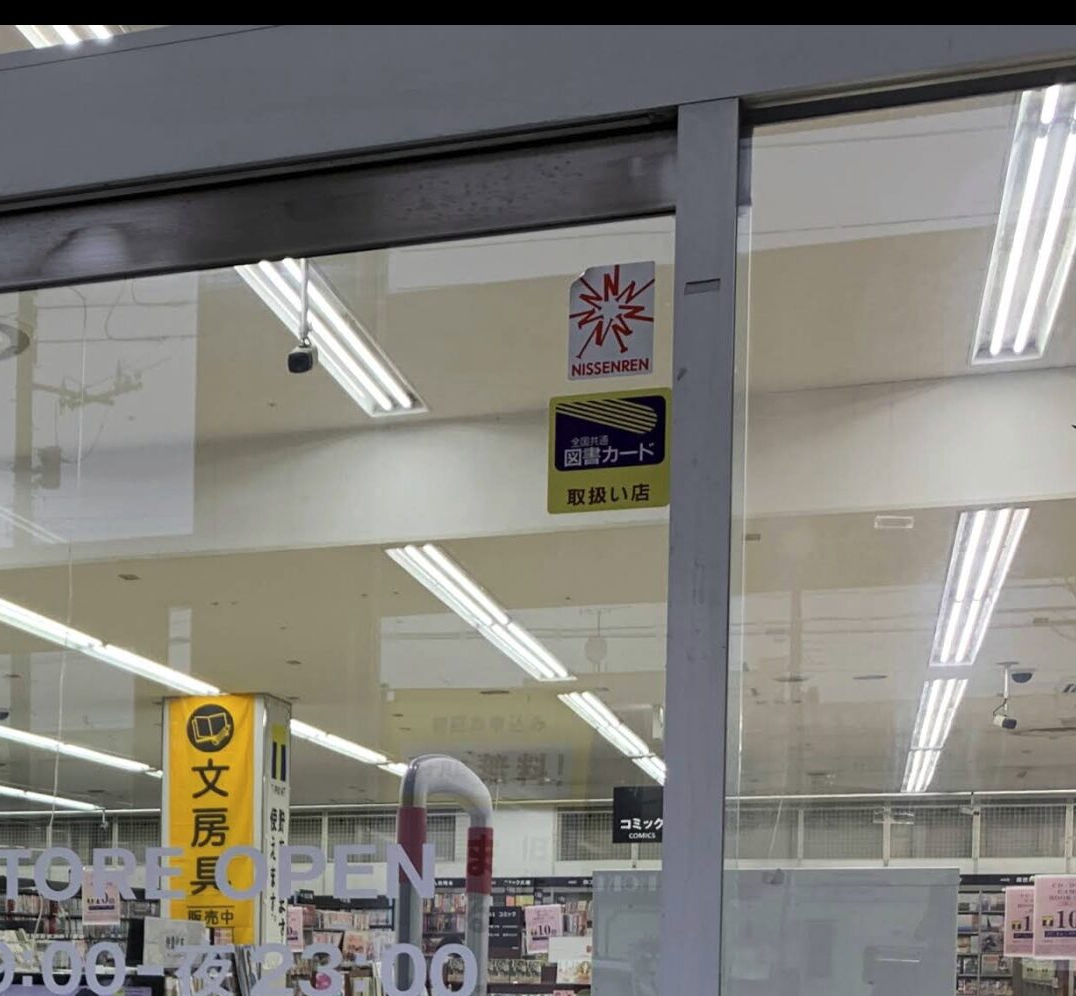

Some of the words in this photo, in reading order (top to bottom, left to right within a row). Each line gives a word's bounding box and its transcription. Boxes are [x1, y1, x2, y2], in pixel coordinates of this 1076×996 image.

[571, 358, 650, 377] NISSENREN
[571, 434, 609, 447] 全国共通
[564, 442, 655, 468] 図書カード
[567, 483, 650, 506] 取扱い店
[190, 758, 230, 895] 文房具
[619, 817, 664, 831] コミック
[214, 842, 435, 900] OPEN
[188, 909, 235, 926] 販売中
